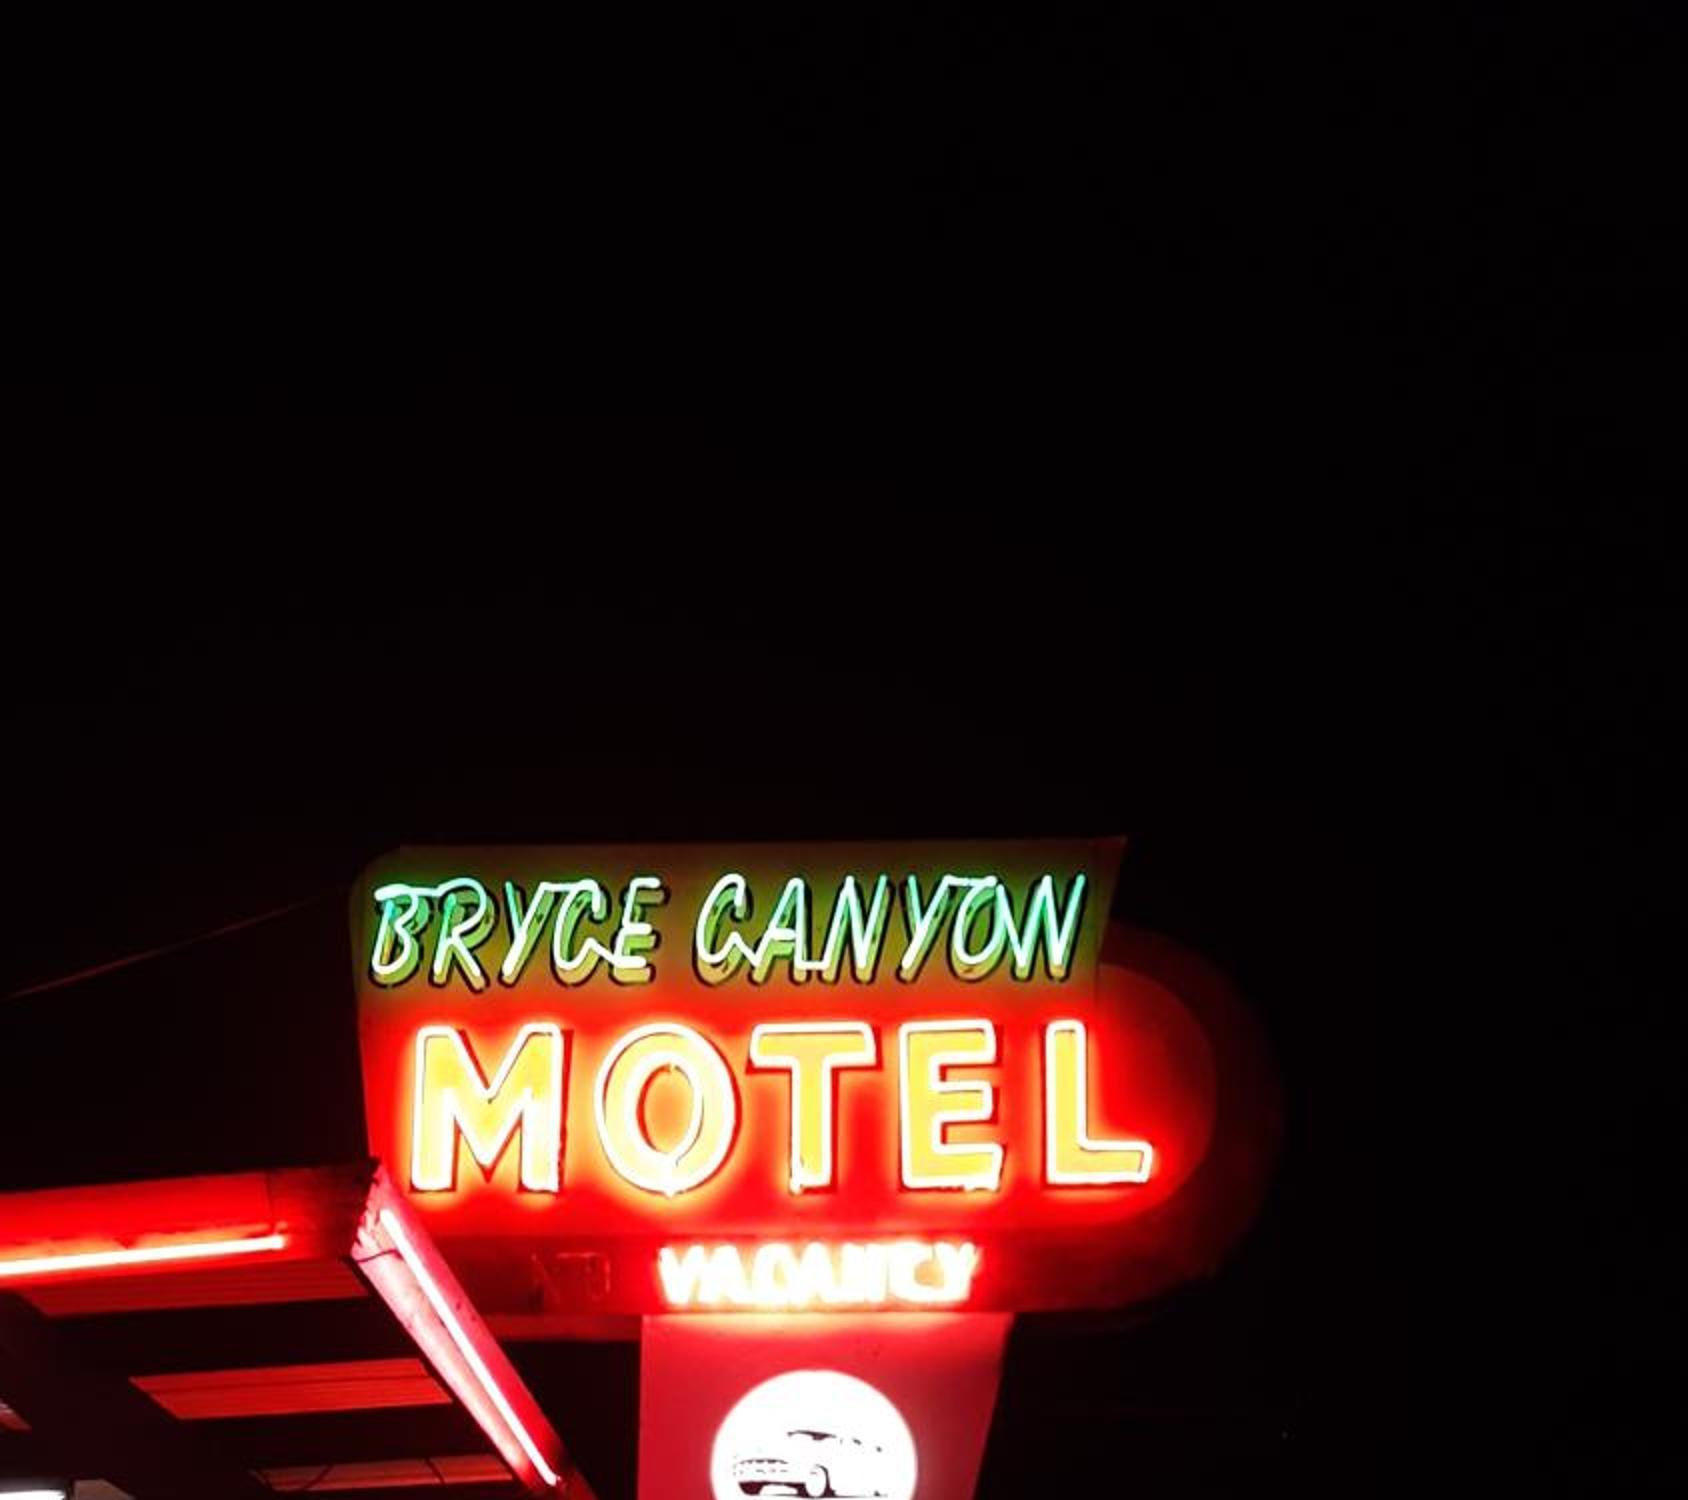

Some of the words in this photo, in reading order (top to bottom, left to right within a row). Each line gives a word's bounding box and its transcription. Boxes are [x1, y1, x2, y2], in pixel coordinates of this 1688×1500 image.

[369, 877, 665, 988] BRYCE
[690, 873, 1088, 984] CANYON
[408, 1020, 1156, 1195] MOTEL
[657, 1242, 978, 1306] VACANCY
